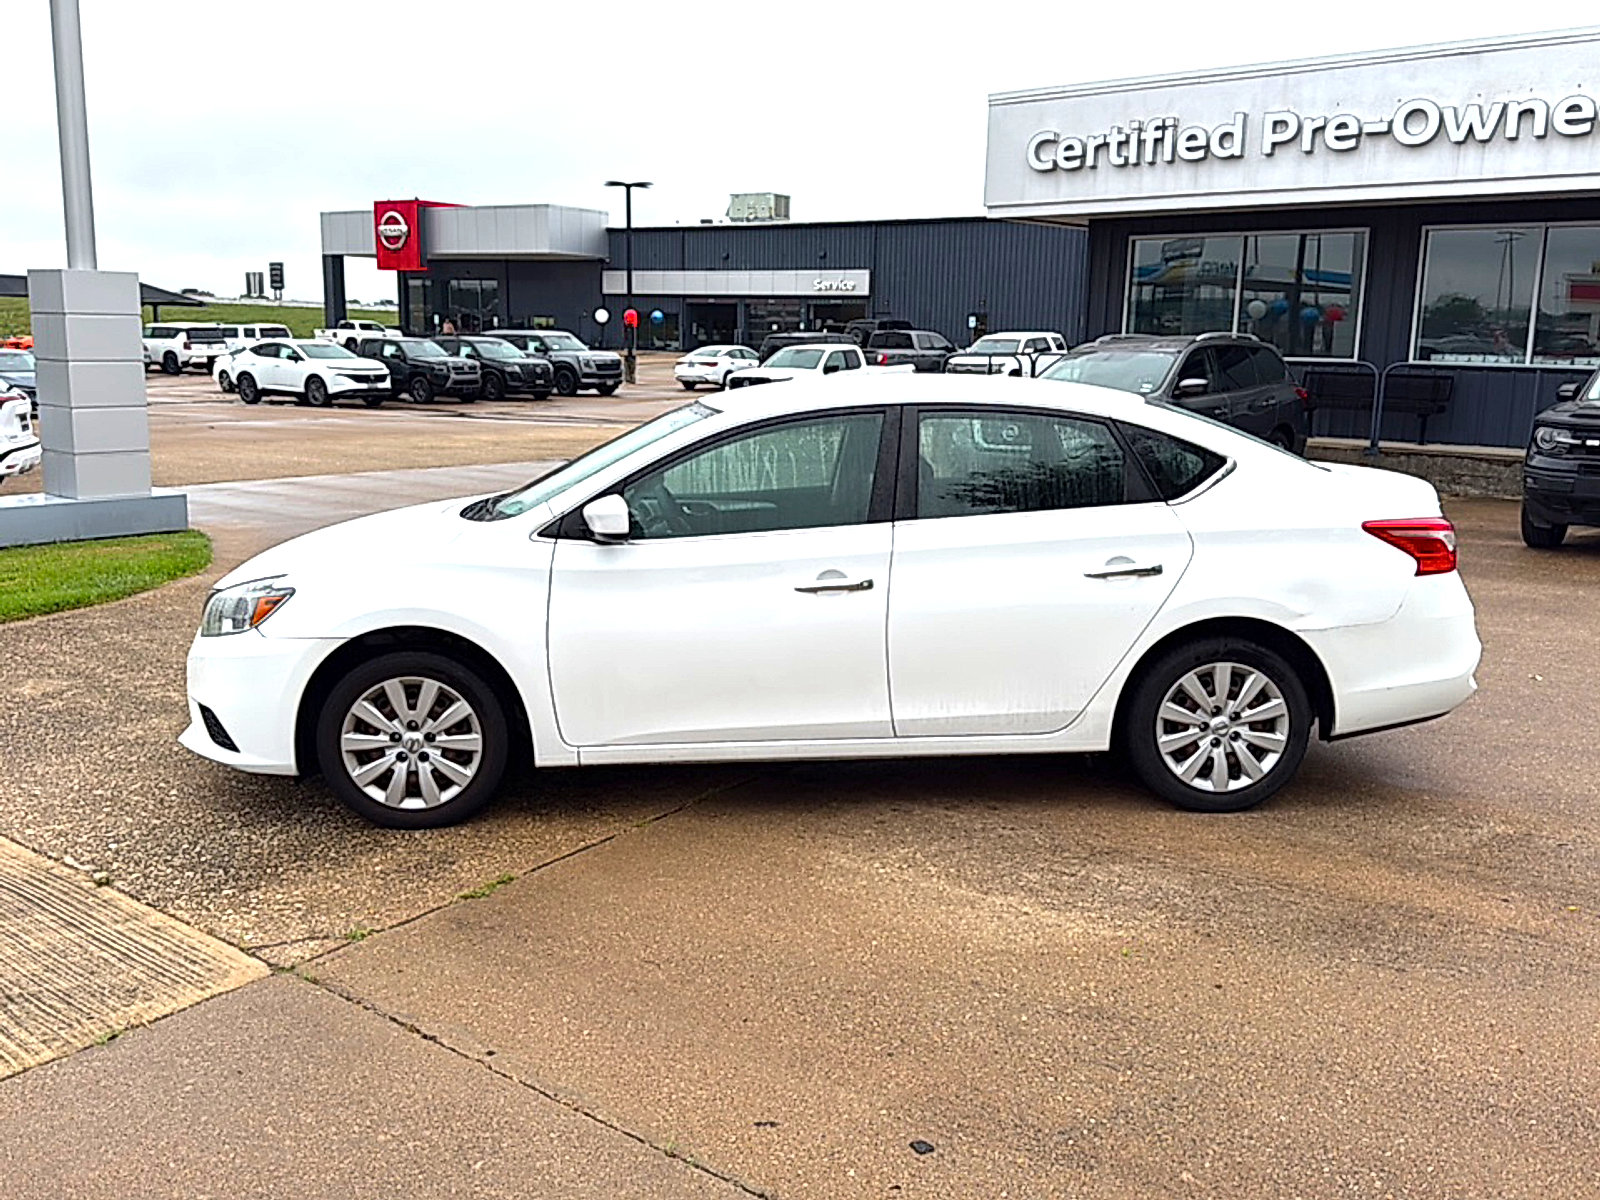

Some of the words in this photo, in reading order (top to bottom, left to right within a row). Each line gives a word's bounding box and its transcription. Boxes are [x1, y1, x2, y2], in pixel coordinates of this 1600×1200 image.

[1026, 112, 1248, 173] Certified
[1261, 94, 1600, 157] Pre-Owne
[813, 278, 856, 291] Service
